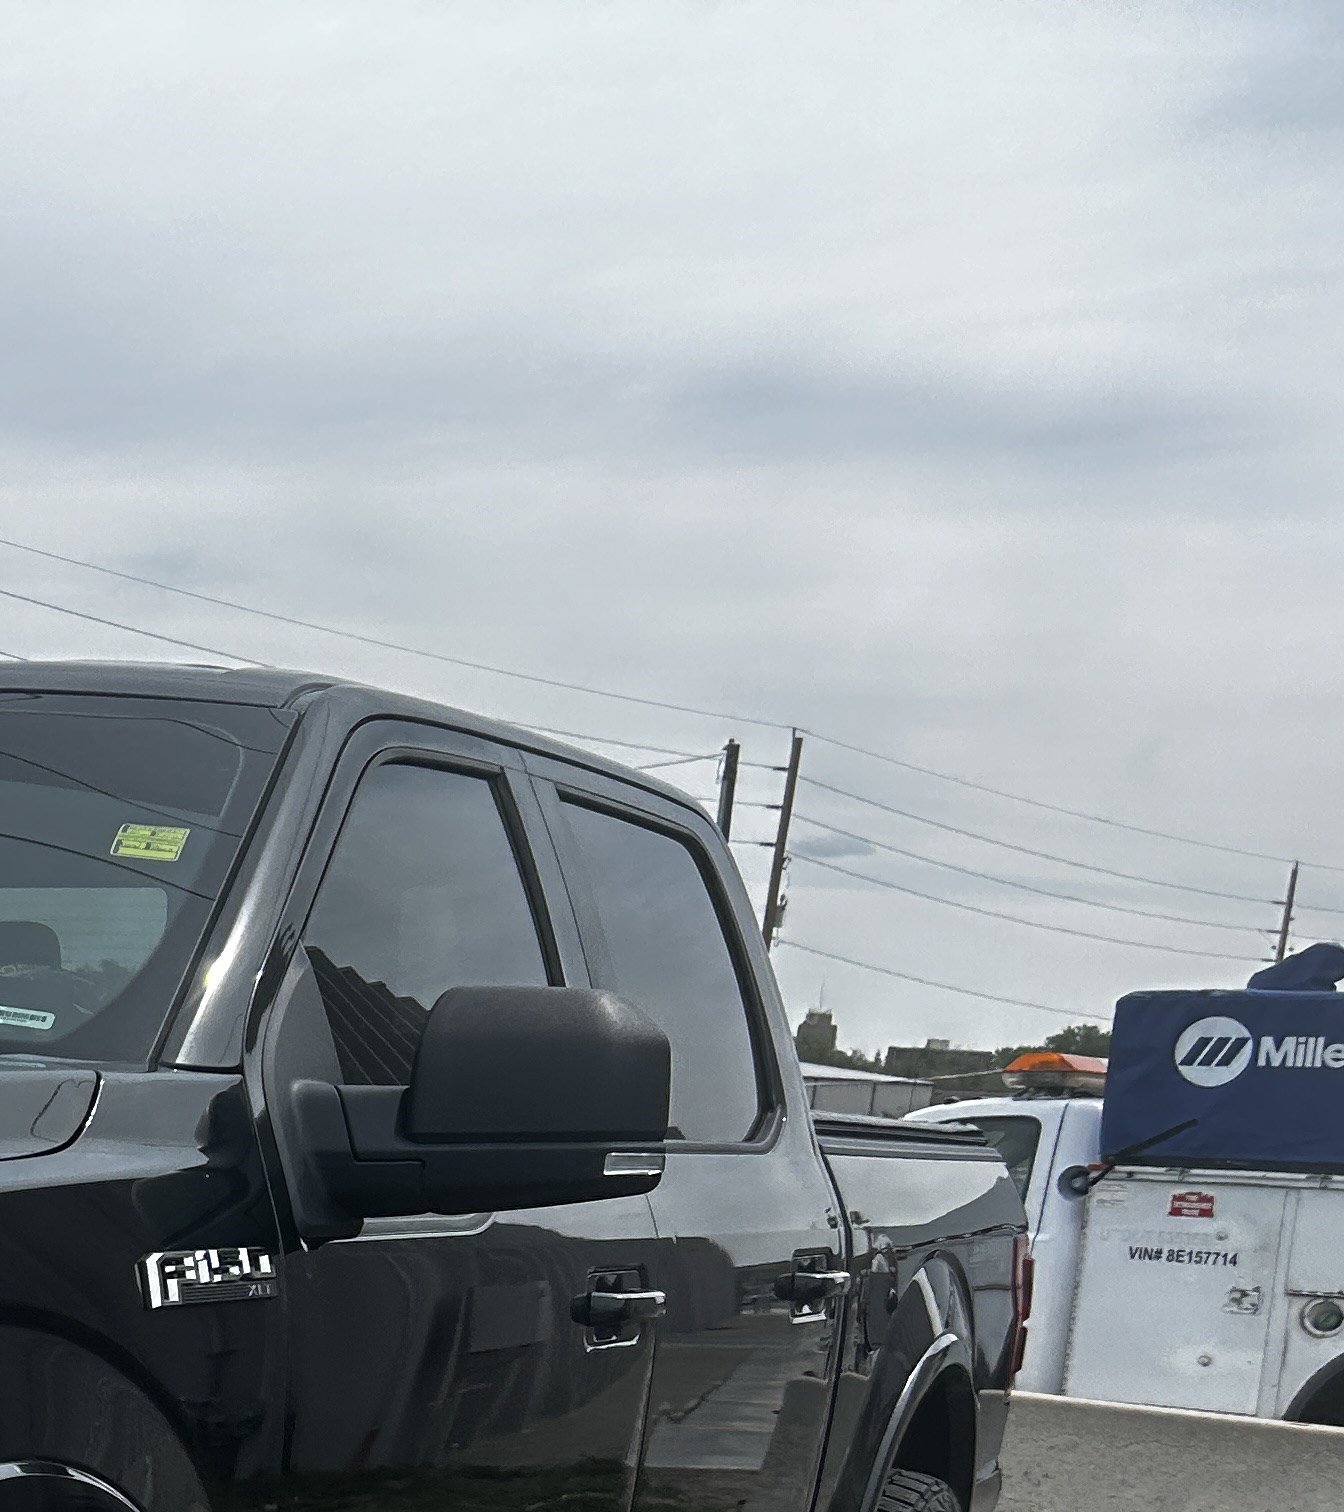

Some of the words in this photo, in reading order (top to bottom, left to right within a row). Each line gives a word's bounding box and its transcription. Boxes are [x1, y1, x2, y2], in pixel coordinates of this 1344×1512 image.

[1256, 1035, 1344, 1068] Mille
[1128, 1245, 1163, 1261] VIN#
[1165, 1248, 1239, 1267] 8E157714
